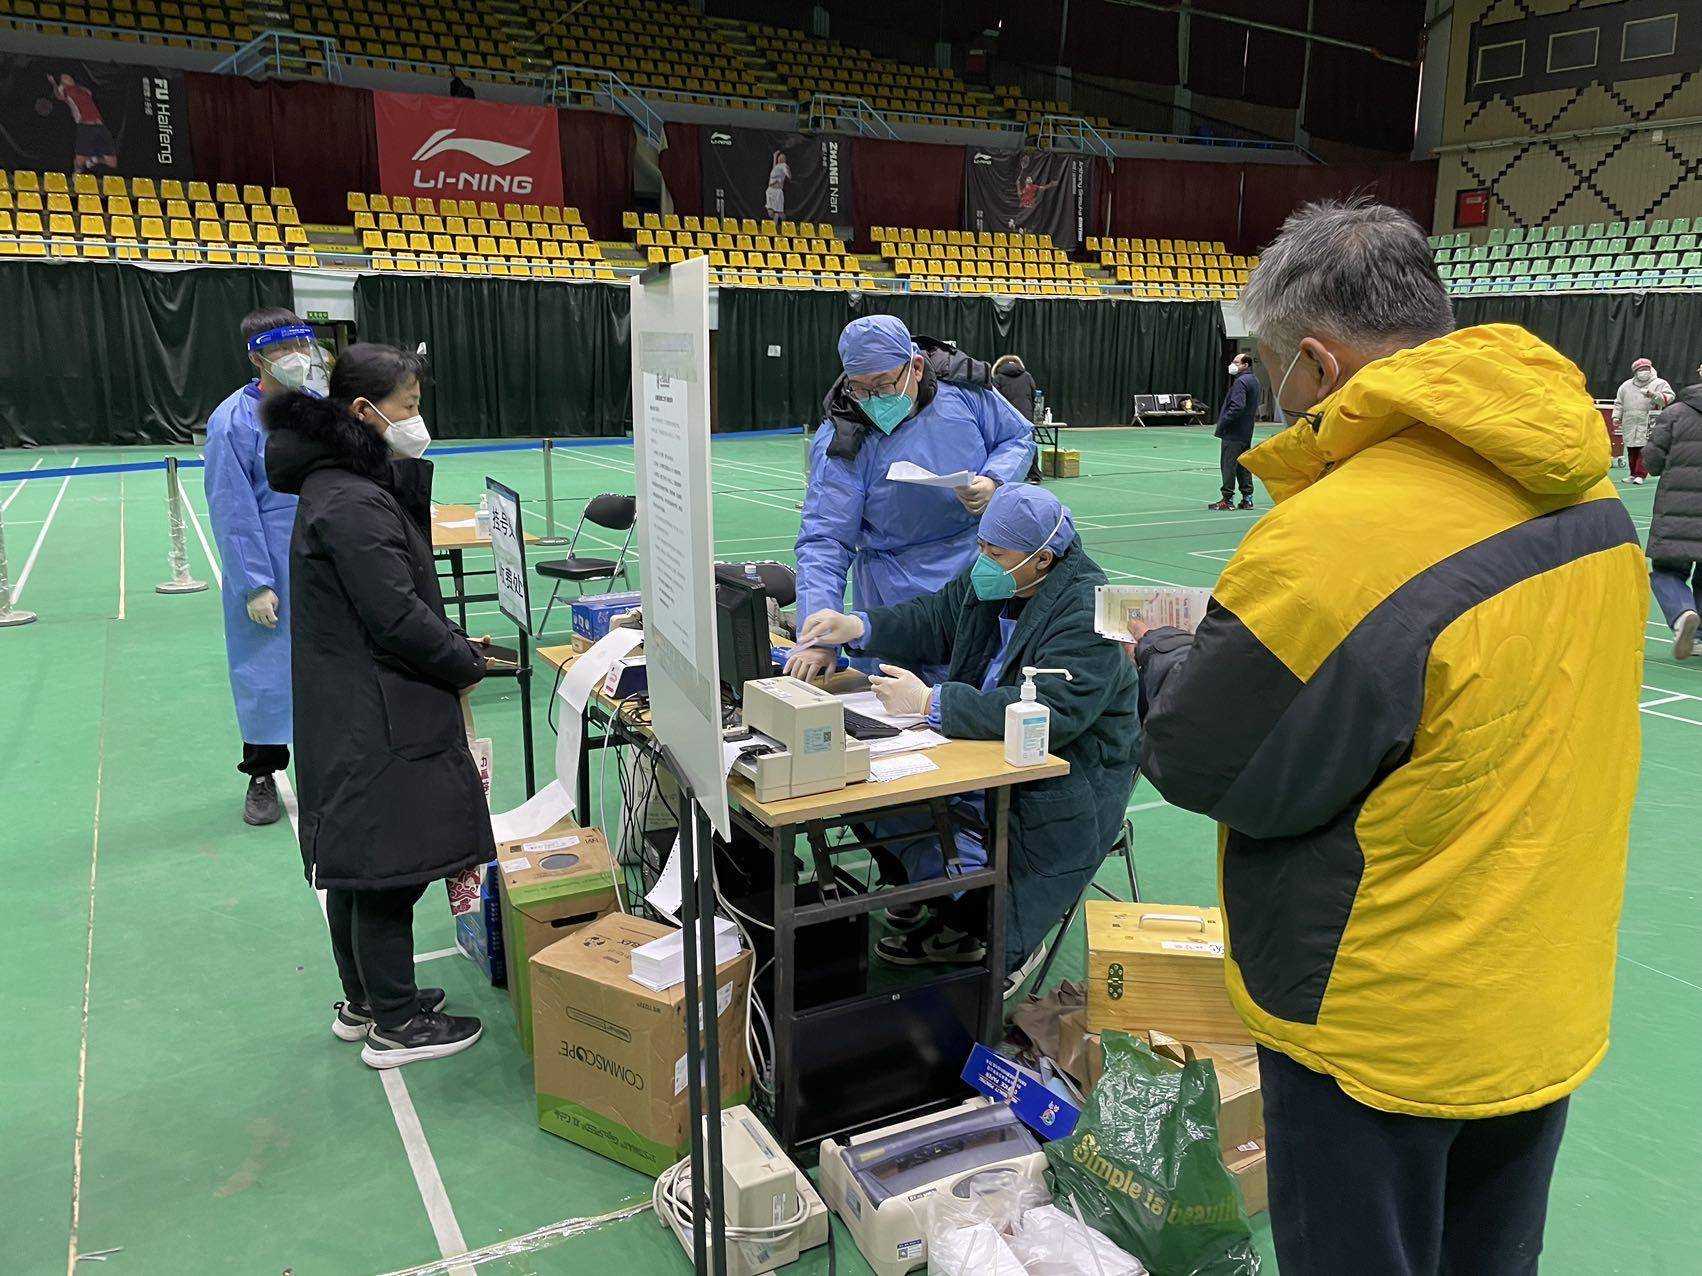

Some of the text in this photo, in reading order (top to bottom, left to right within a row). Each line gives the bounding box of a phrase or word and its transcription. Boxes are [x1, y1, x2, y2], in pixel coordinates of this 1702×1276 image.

[154, 78, 173, 164] FU Haifeng
[413, 168, 533, 195] LI-NING
[829, 141, 840, 214] ZHANG Nan
[559, 1040, 645, 1091] COMMSCOPE
[1072, 1133, 1143, 1199] Simple
[1143, 1189, 1168, 1216] is
